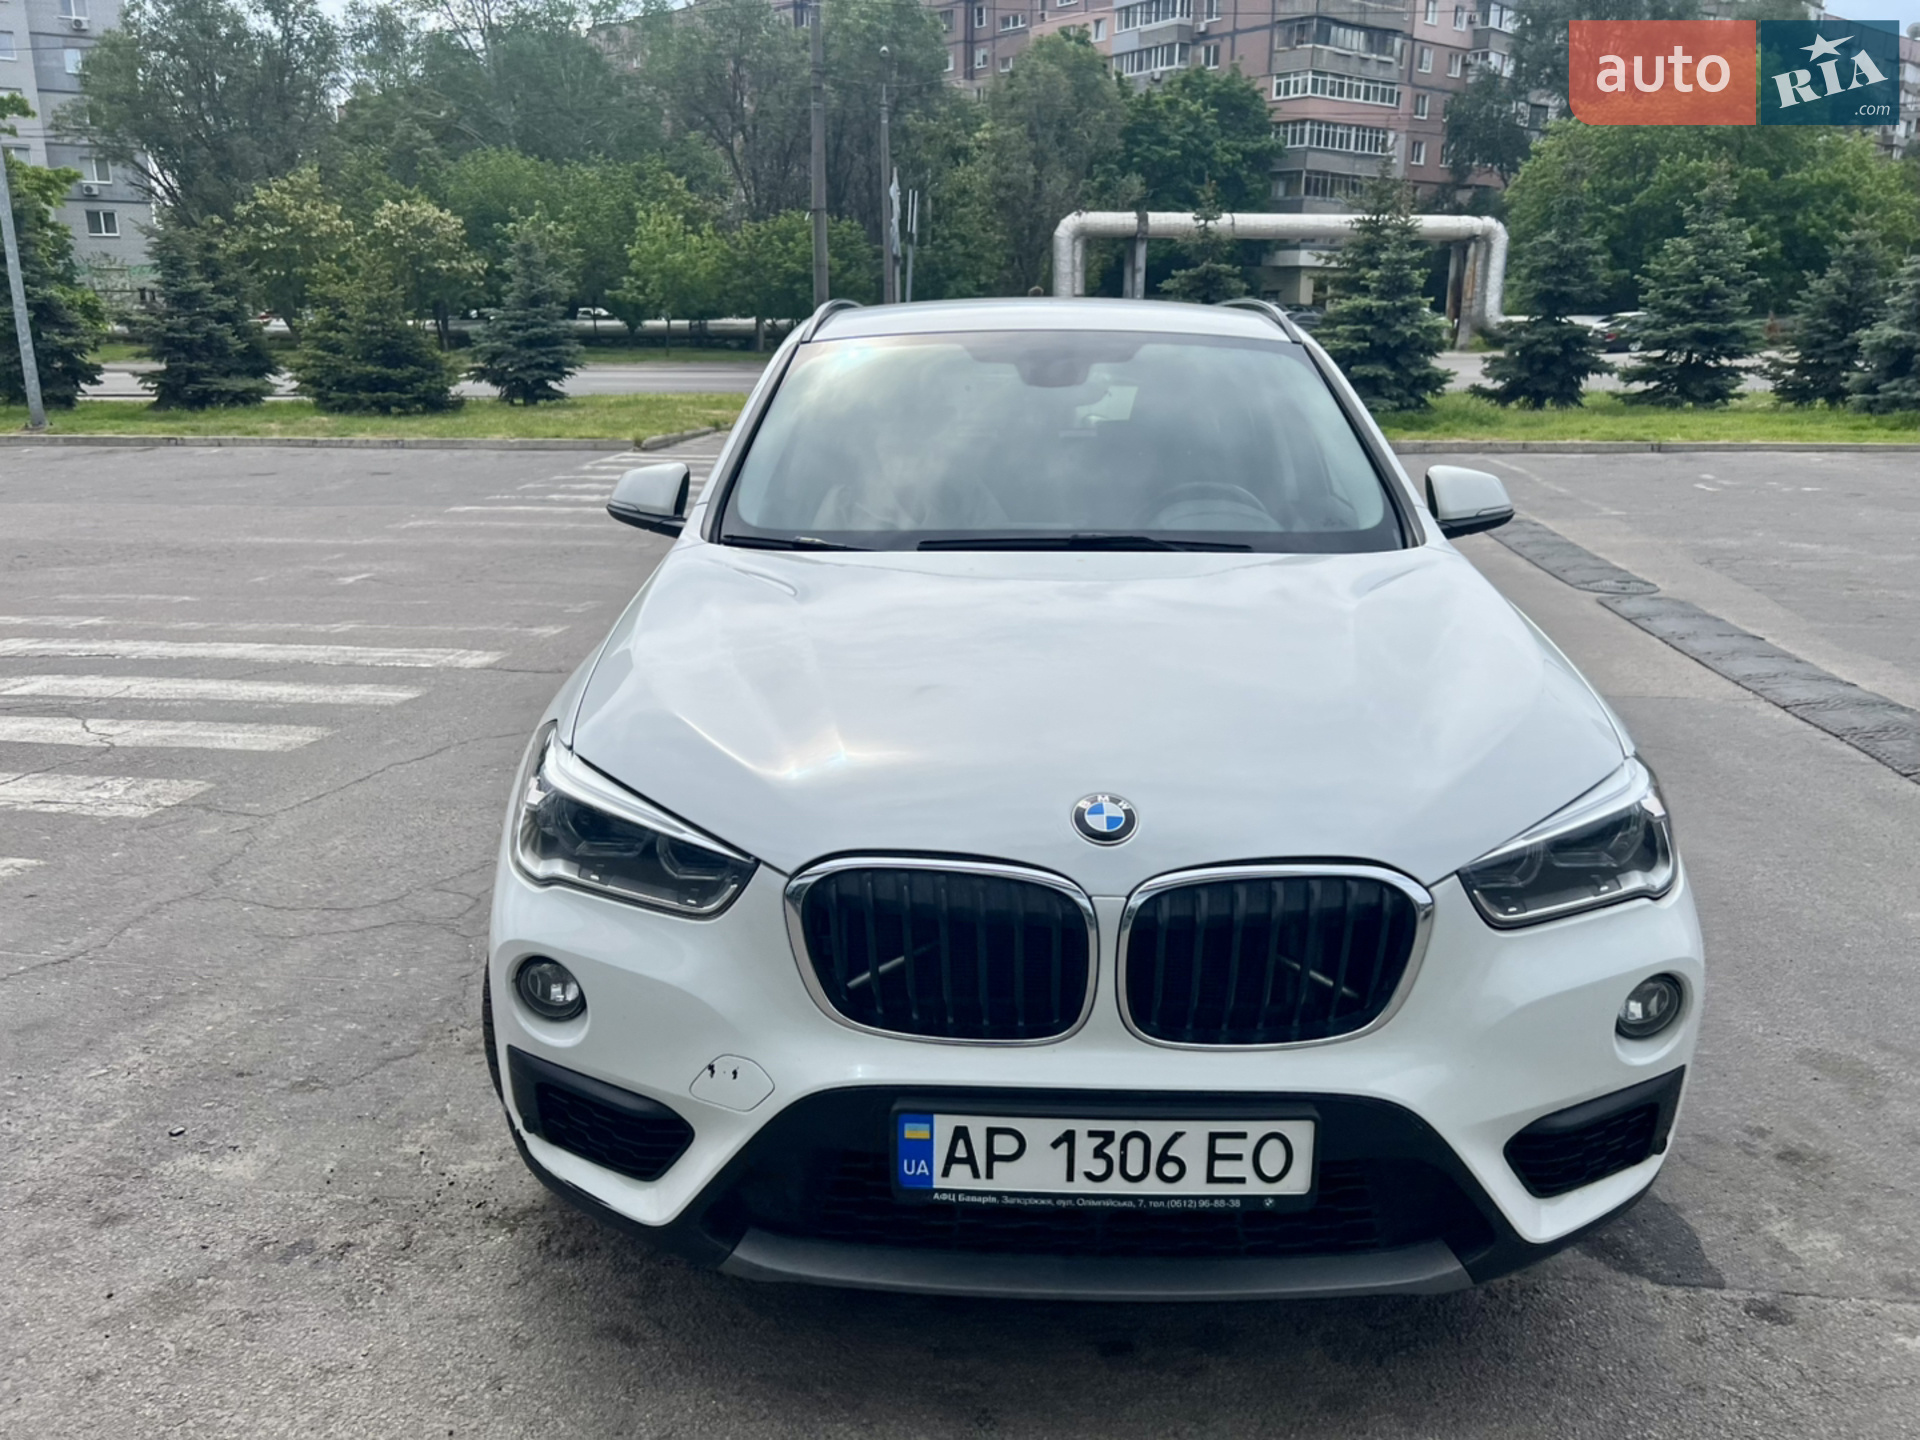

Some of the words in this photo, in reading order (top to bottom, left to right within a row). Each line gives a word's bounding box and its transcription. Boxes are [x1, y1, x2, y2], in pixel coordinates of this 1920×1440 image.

[1077, 794, 1132, 810] BMW
[940, 1125, 1027, 1180] AP
[1050, 1128, 1187, 1184] 1306
[1205, 1130, 1294, 1184] EO
[903, 1159, 930, 1177] UA
